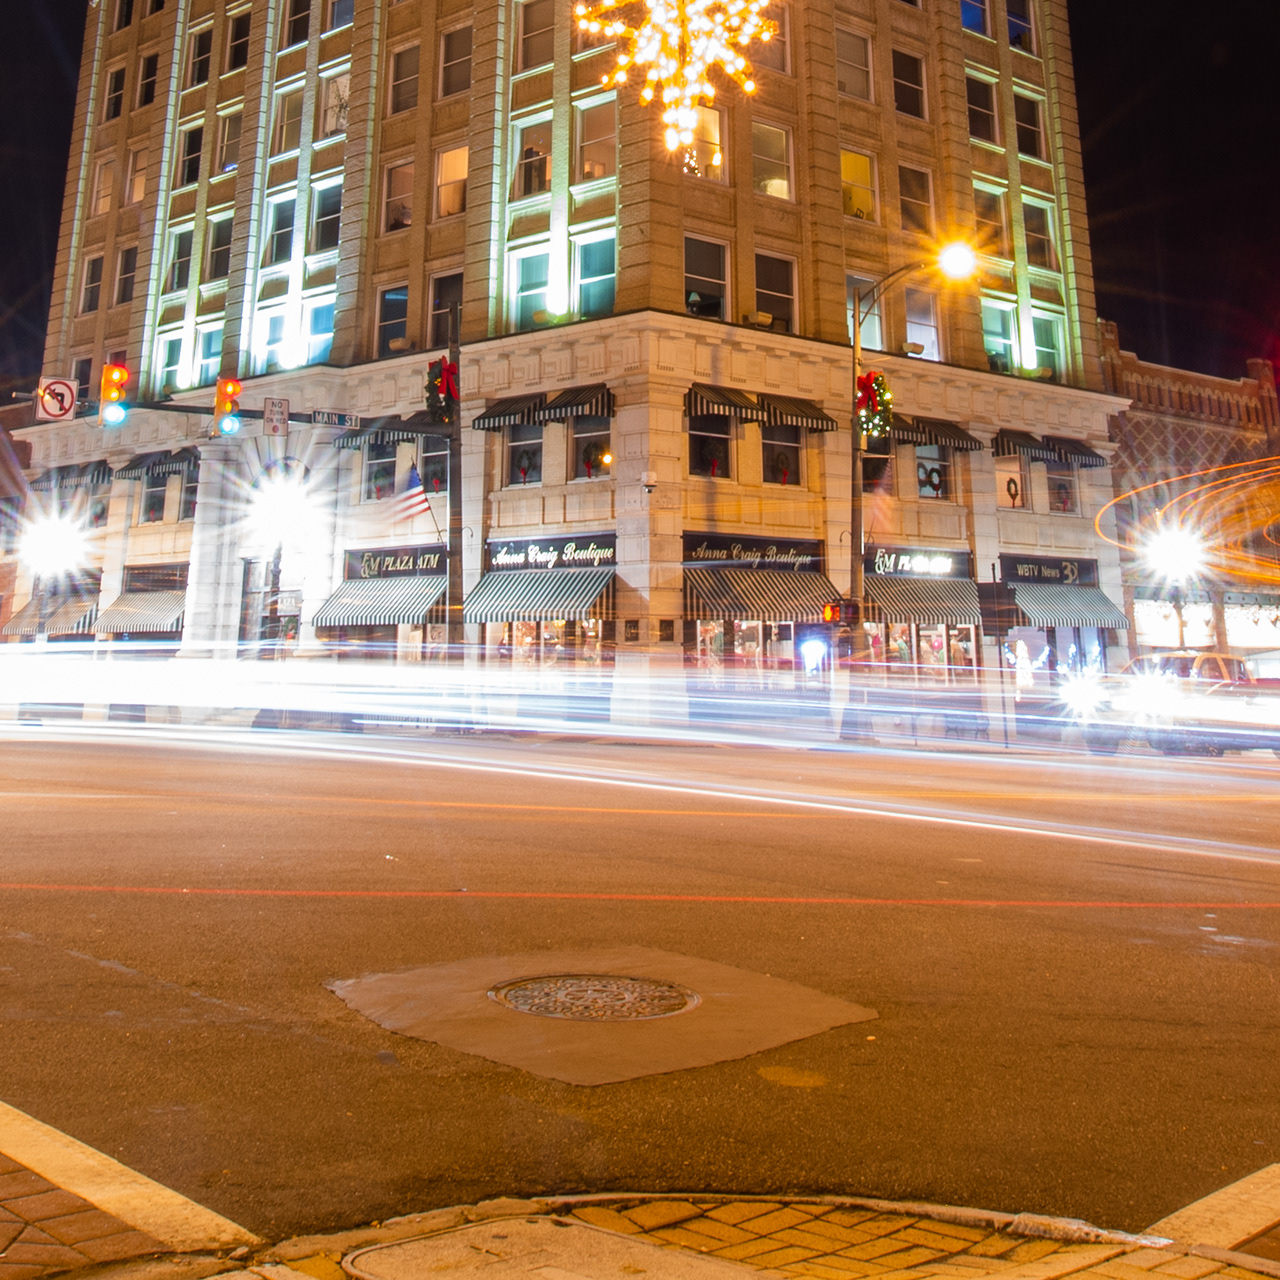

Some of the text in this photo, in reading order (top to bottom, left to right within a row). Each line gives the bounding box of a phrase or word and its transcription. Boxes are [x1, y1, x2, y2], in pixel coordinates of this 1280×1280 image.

[271, 400, 283, 409] NO
[314, 412, 357, 427] MAIN ST
[382, 556, 415, 571] PLAZA
[416, 553, 441, 569] ATM
[491, 542, 614, 569] Anna Craig Boutique
[692, 541, 812, 571] Anna Craig Boutique
[1016, 563, 1039, 577] WBTV
[1041, 565, 1061, 578] News
